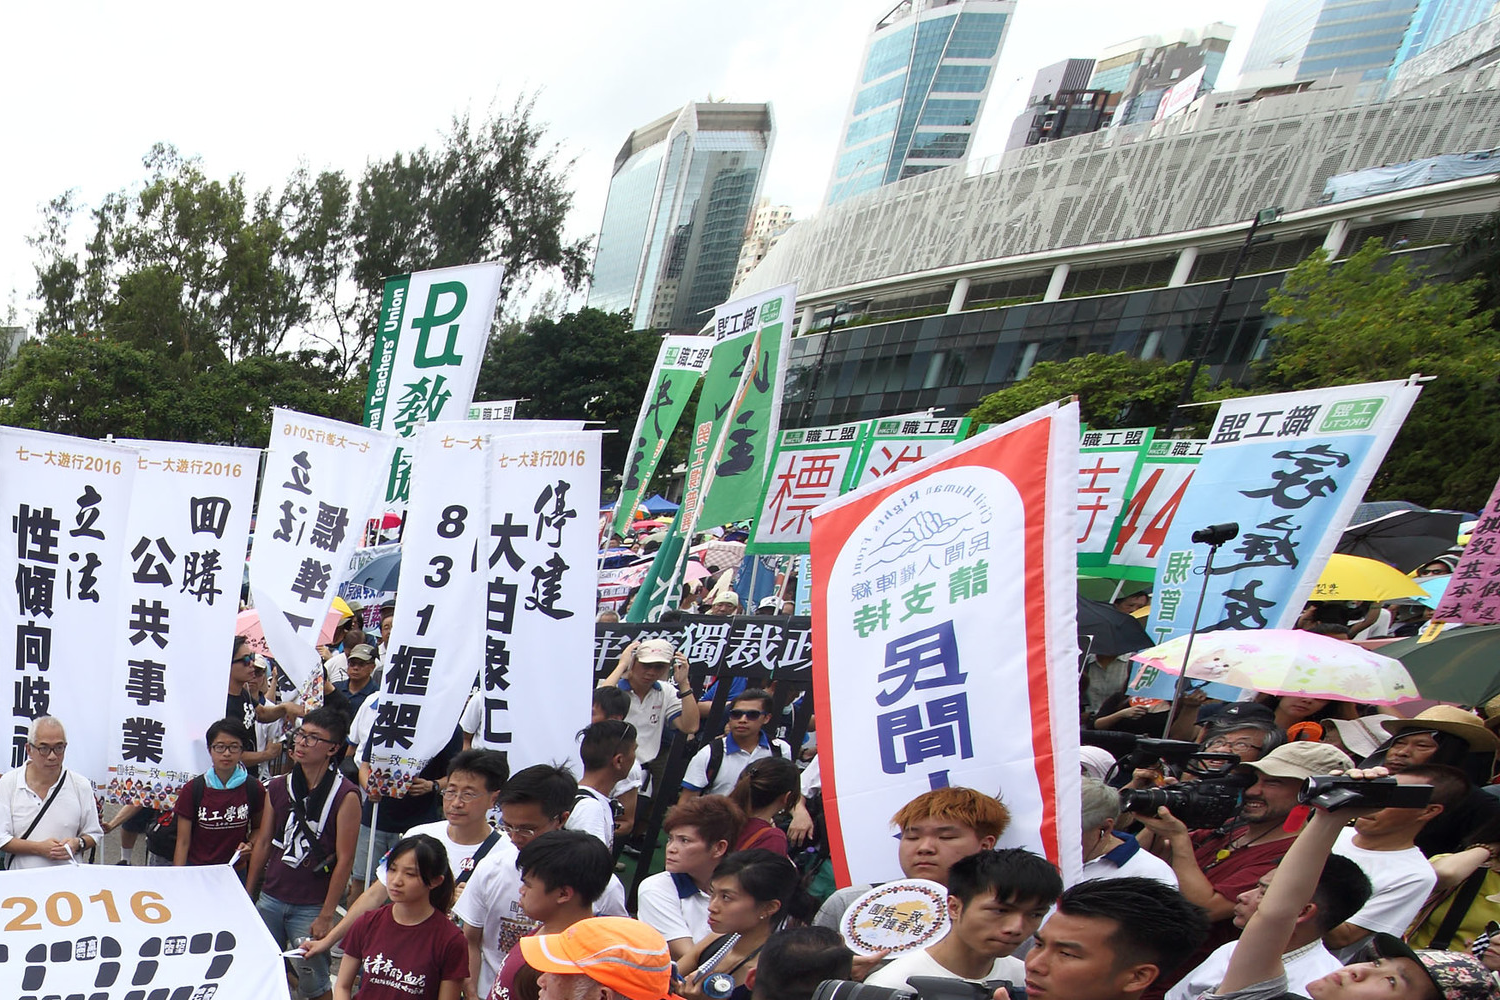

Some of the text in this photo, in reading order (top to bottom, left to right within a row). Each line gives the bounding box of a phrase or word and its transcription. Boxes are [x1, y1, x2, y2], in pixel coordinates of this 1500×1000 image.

[384, 287, 405, 332] Union
[805, 426, 856, 443] 職工盟
[902, 419, 958, 435] 職工盟
[1082, 431, 1143, 447] 職工盟
[16, 446, 121, 475] 七一大遊行2016
[137, 456, 242, 478] 七一大遊行2016
[1113, 468, 1196, 558] 44
[66, 485, 106, 603] 立法
[524, 478, 577, 620] 停建
[121, 536, 176, 764] 公共事業
[375, 504, 468, 750] 831框架
[594, 622, 812, 672] 牢獨裁政
